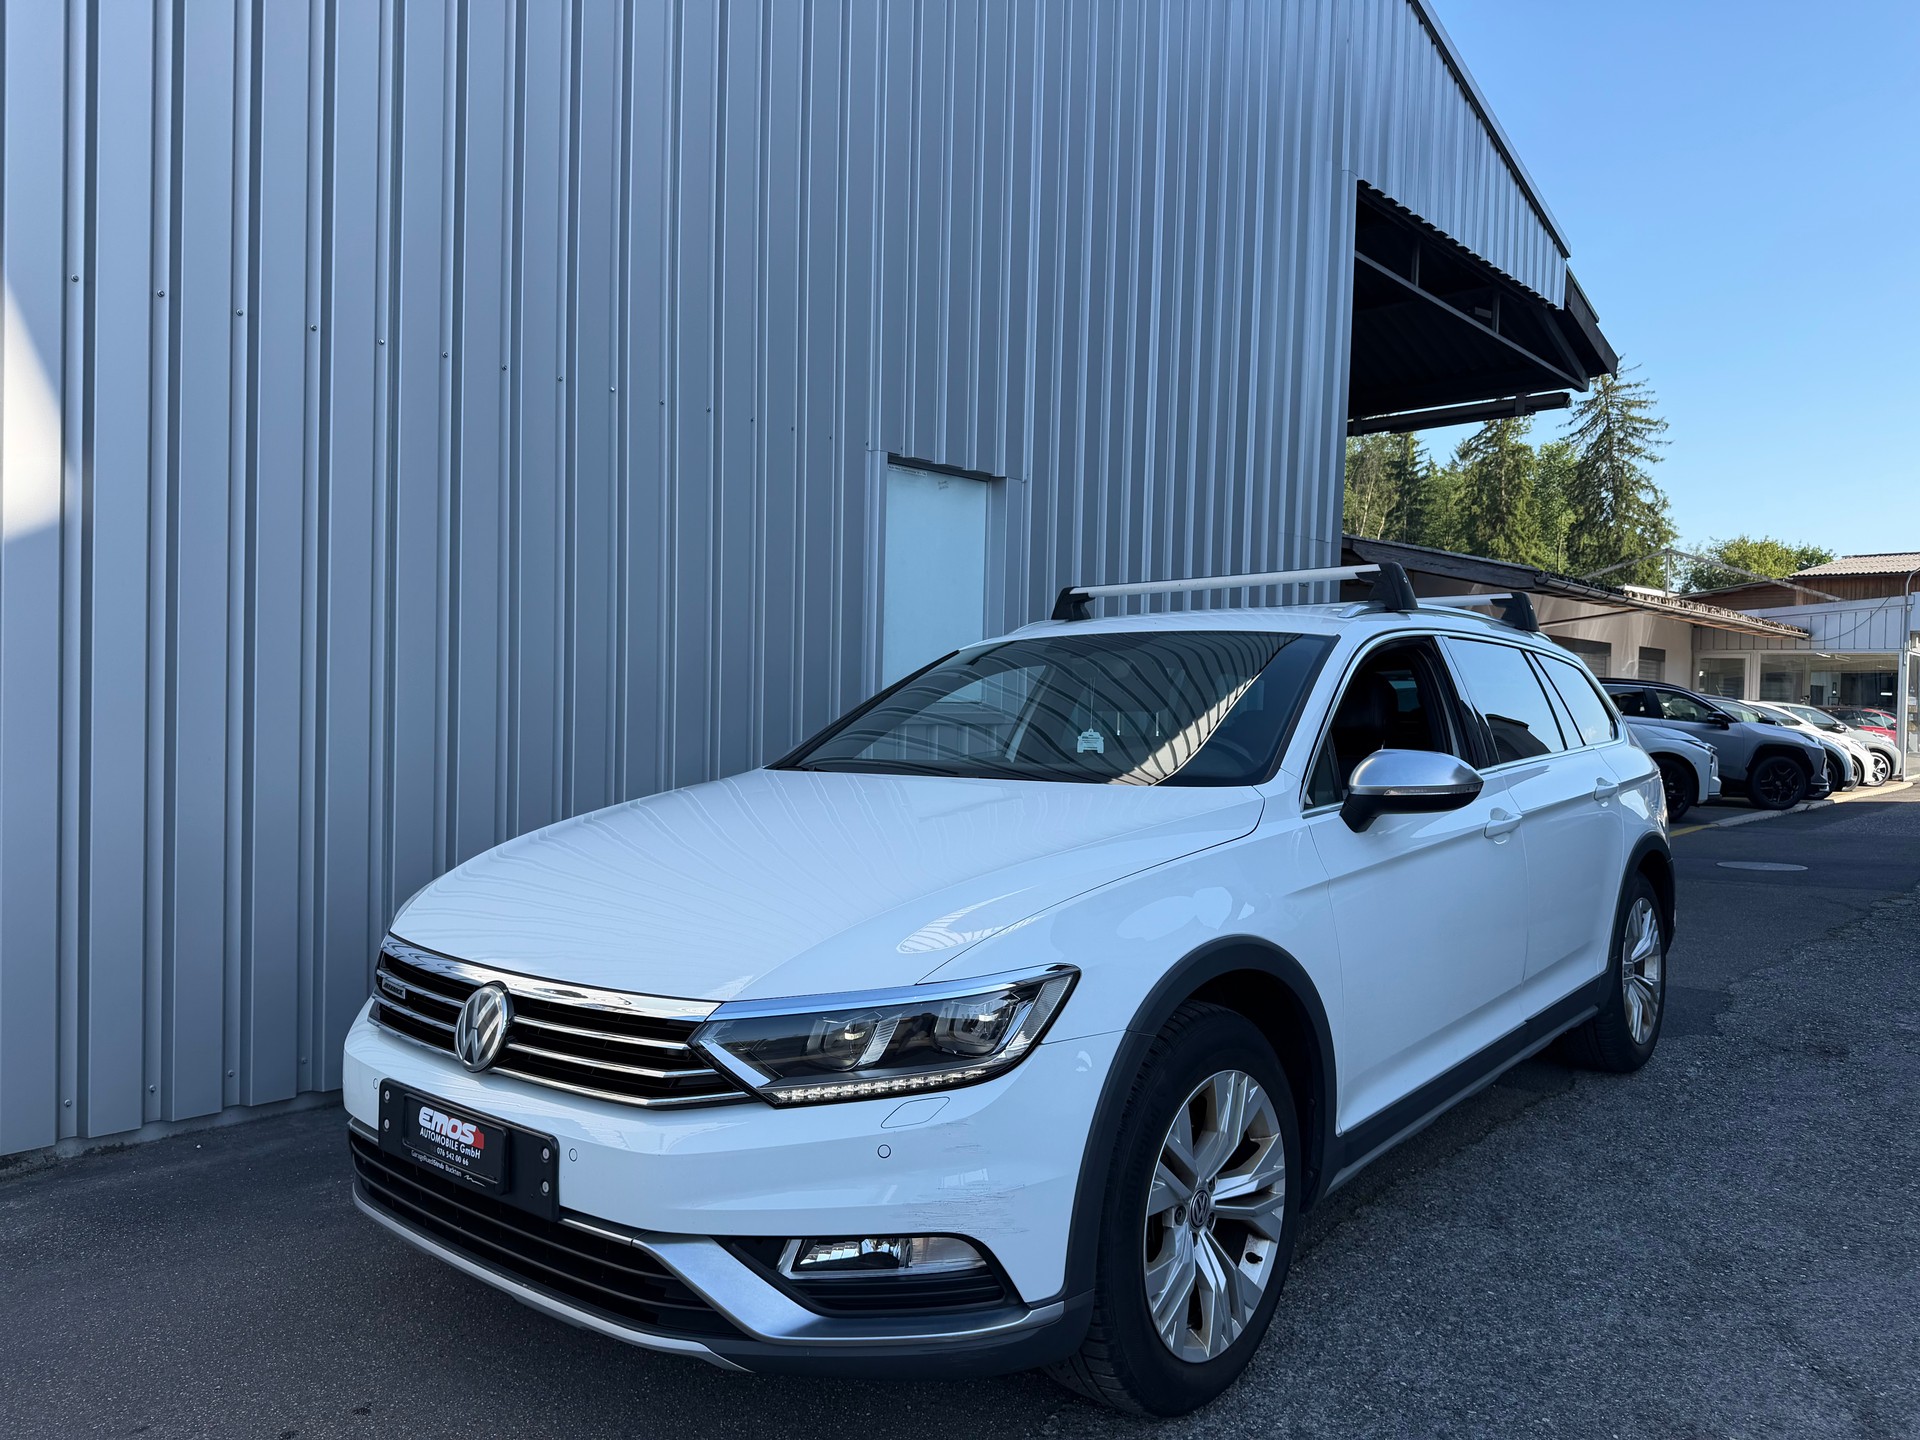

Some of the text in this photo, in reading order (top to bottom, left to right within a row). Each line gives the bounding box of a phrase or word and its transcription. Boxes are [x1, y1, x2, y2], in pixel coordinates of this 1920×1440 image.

[420, 1127, 481, 1159] AUTOMOBILE GmbH
[436, 1147, 469, 1166] 076 542 00 66
